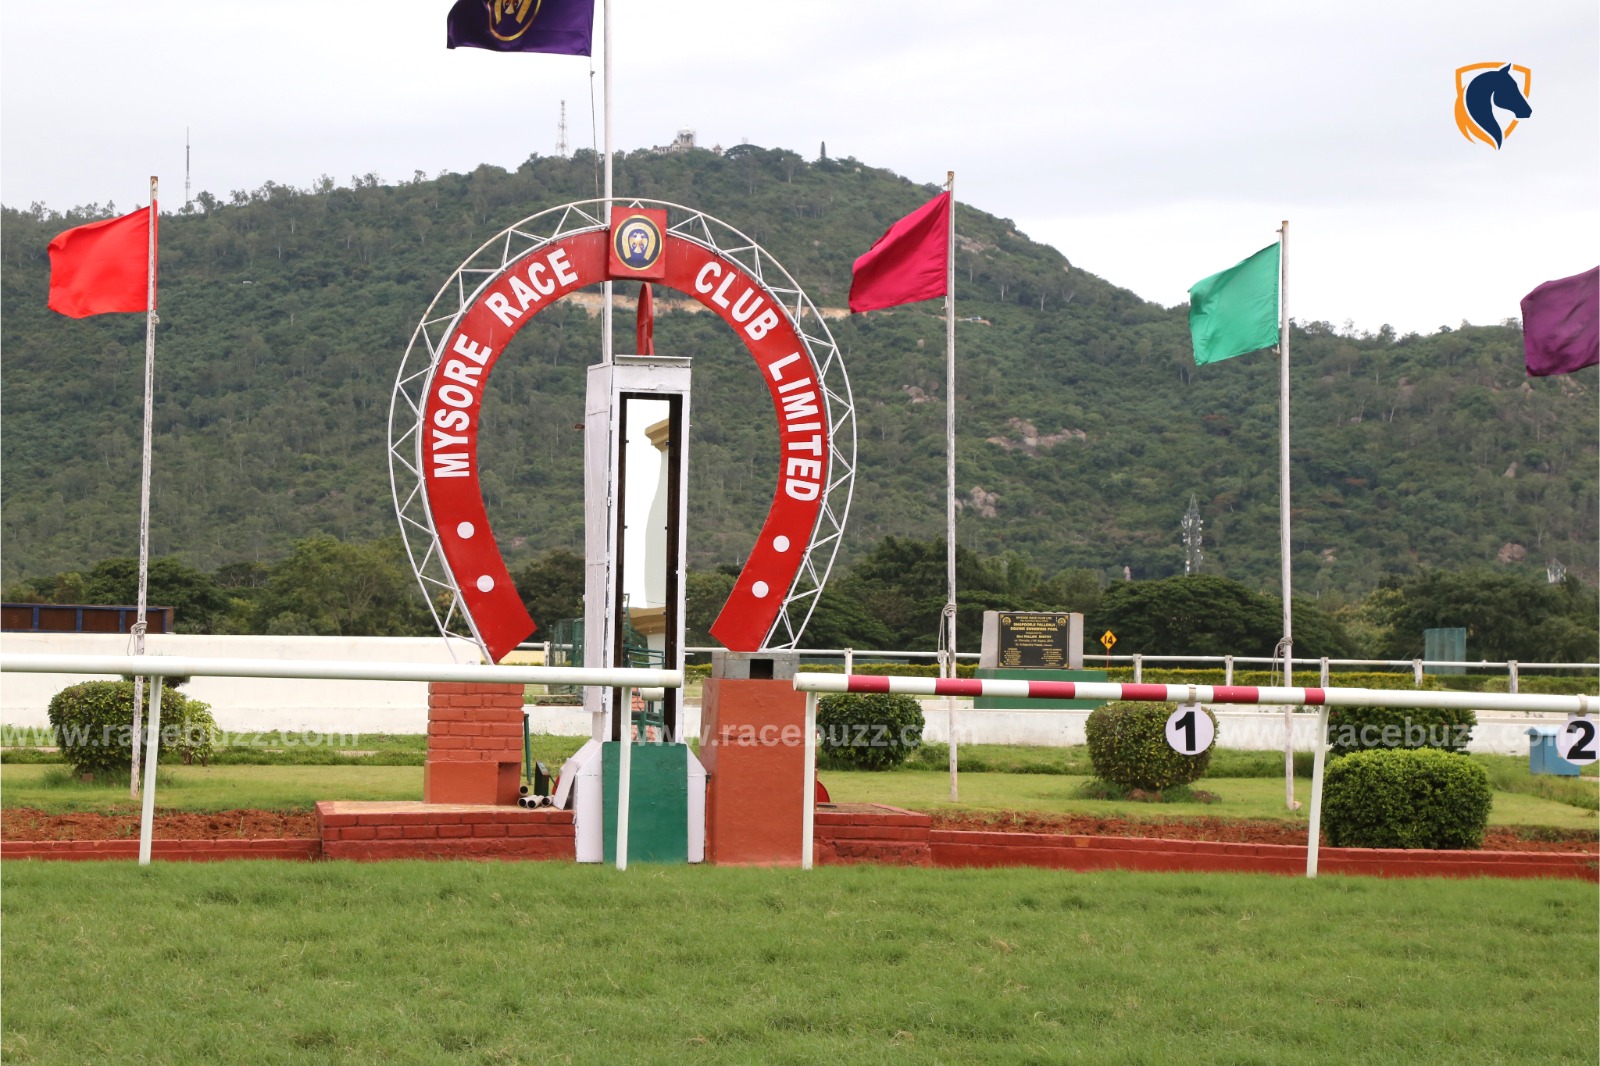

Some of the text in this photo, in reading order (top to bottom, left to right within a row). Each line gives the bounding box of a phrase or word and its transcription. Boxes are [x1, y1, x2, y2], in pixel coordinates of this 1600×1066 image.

[433, 248, 822, 502] MYSORE RACE CLUB LIMITED
[1104, 635, 1114, 645] 14
[1175, 711, 1196, 751] 1
[1566, 720, 1597, 760] 2
